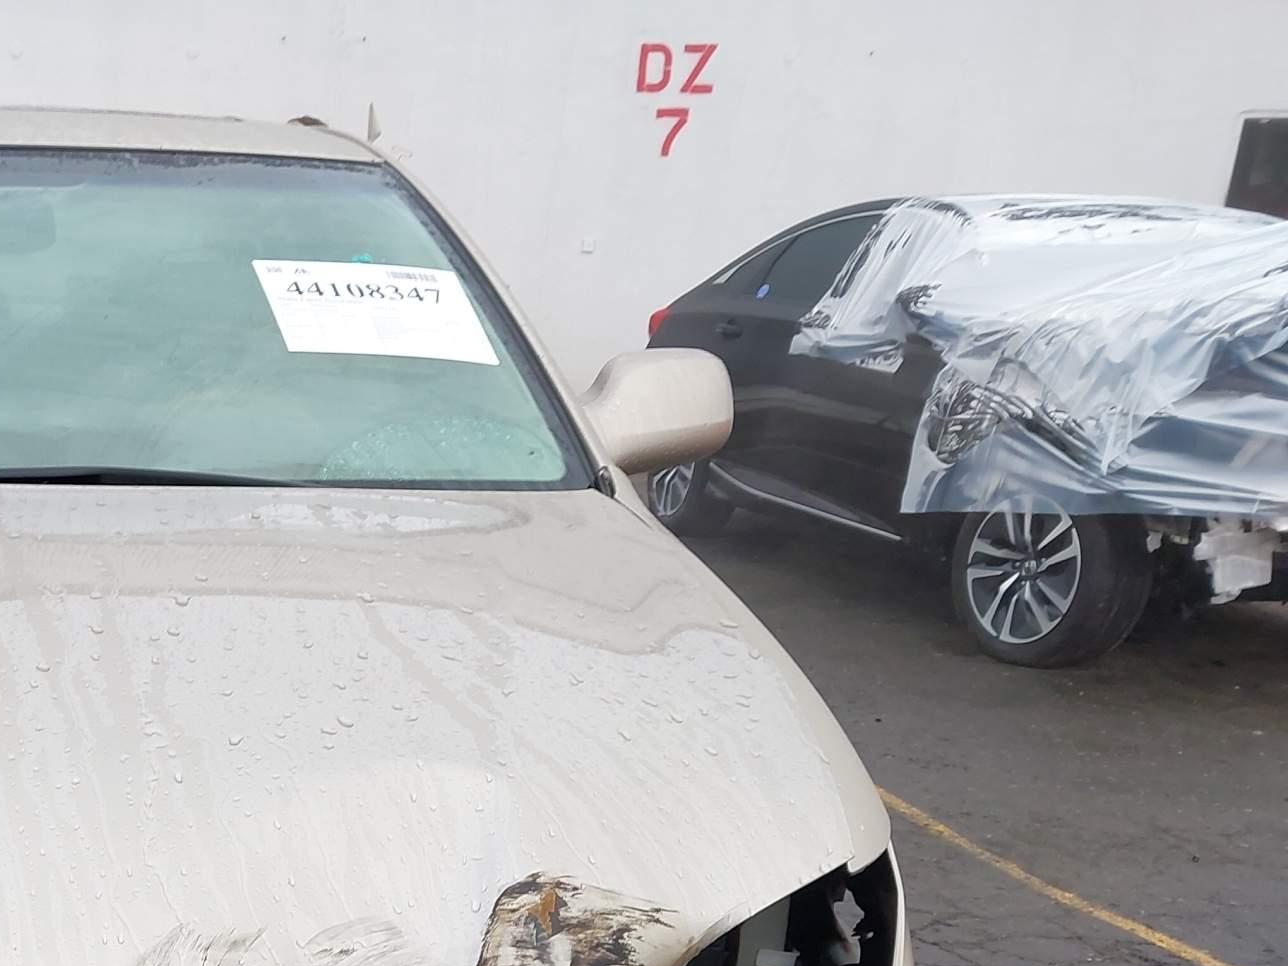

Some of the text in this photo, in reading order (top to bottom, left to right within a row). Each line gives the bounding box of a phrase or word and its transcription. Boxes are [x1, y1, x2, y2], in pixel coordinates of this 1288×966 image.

[636, 43, 718, 95] DZ
[656, 107, 690, 157] 7
[287, 281, 440, 304] 44108347
